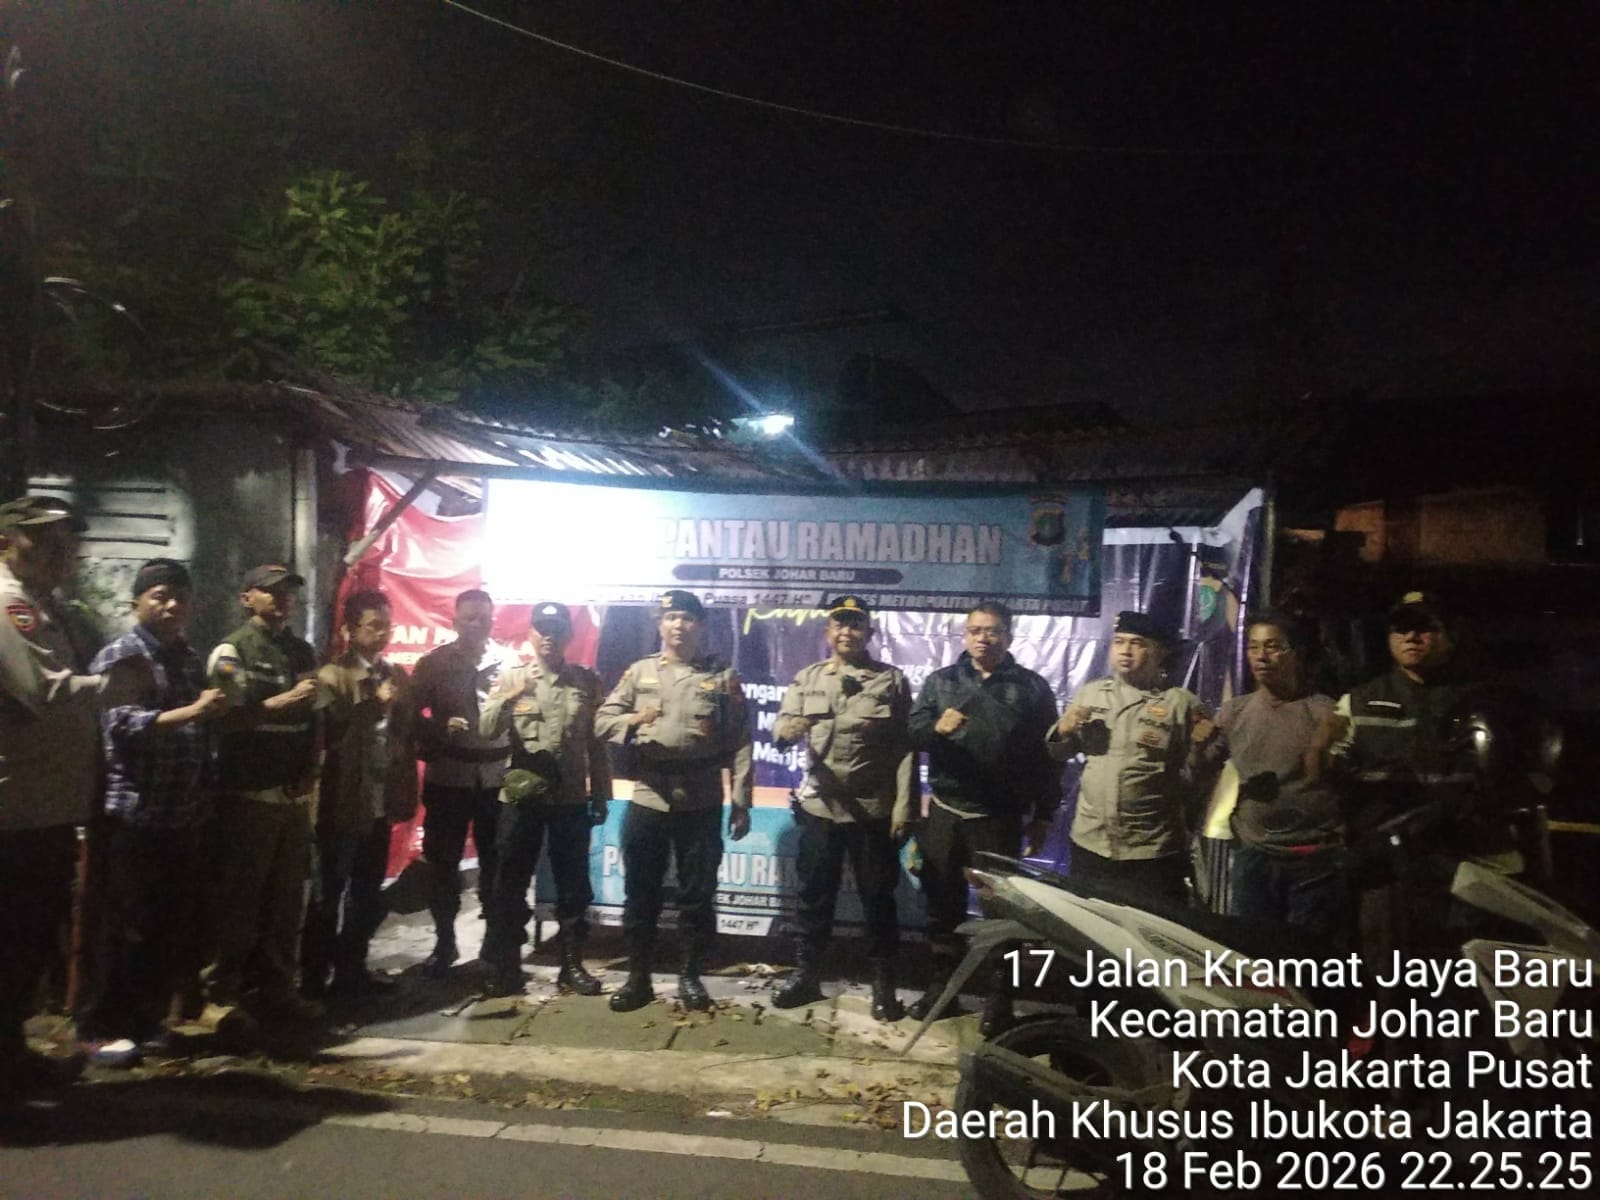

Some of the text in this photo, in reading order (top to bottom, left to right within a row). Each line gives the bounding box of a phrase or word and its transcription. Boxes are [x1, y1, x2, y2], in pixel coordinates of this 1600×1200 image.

[657, 518, 1001, 565] PANTAU RAMADHAN
[719, 568, 856, 581] POLSEK JOHAR BARU
